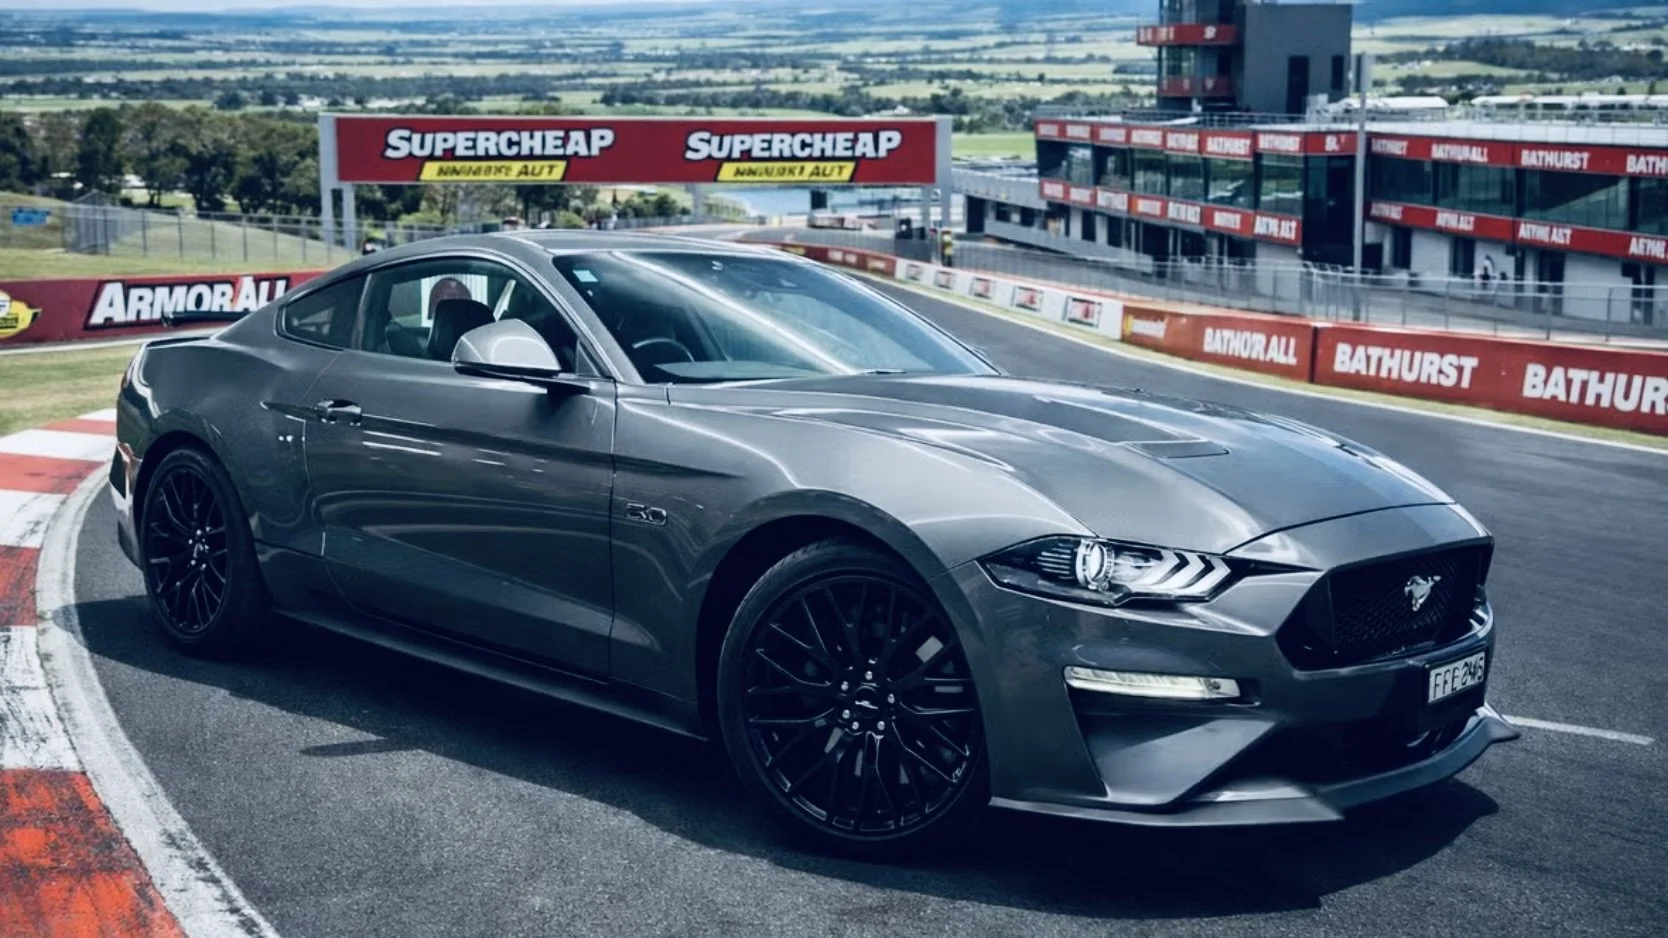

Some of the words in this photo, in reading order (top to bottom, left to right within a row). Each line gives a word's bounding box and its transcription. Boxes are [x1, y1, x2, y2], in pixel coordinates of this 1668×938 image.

[384, 128, 615, 159] SUPERCHEAP
[684, 130, 903, 160] SUPERCHEAP
[1521, 149, 1590, 170] BATHURST
[1626, 154, 1668, 175] BATH
[1333, 343, 1479, 389] BATHURST
[1522, 363, 1668, 415] BATHUR
